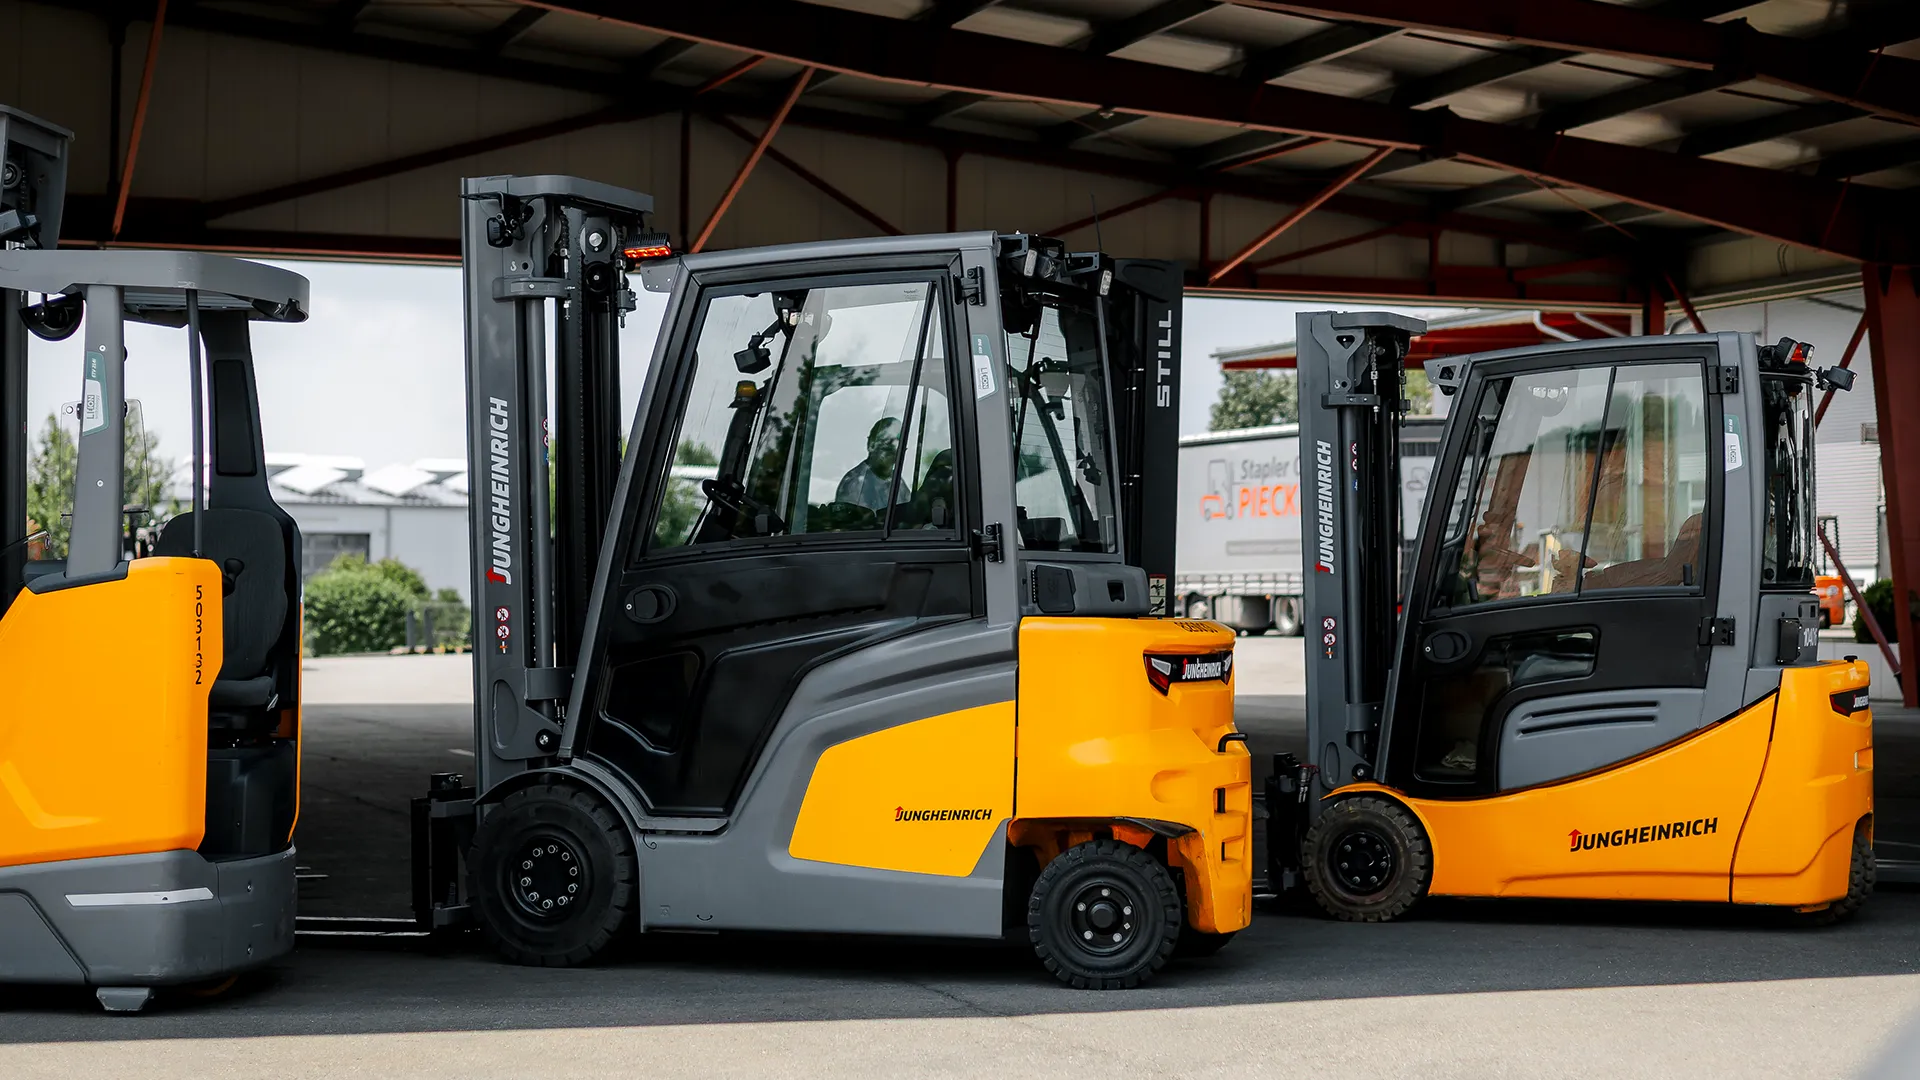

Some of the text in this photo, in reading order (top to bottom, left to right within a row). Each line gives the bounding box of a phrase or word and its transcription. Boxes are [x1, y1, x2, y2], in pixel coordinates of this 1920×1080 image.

[1156, 309, 1172, 408] STILL
[1240, 456, 1290, 484] Stapler
[487, 396, 512, 585] JUNGHEINRICH
[1238, 484, 1301, 519] PIECK
[1315, 440, 1335, 575] JUNGHEINRICH
[195, 584, 203, 685] 503132
[1182, 659, 1222, 680] JUNGHEINRICH
[895, 807, 993, 822] JUNGHEINRICH
[1569, 817, 1718, 853] JUNGHEINRICH
